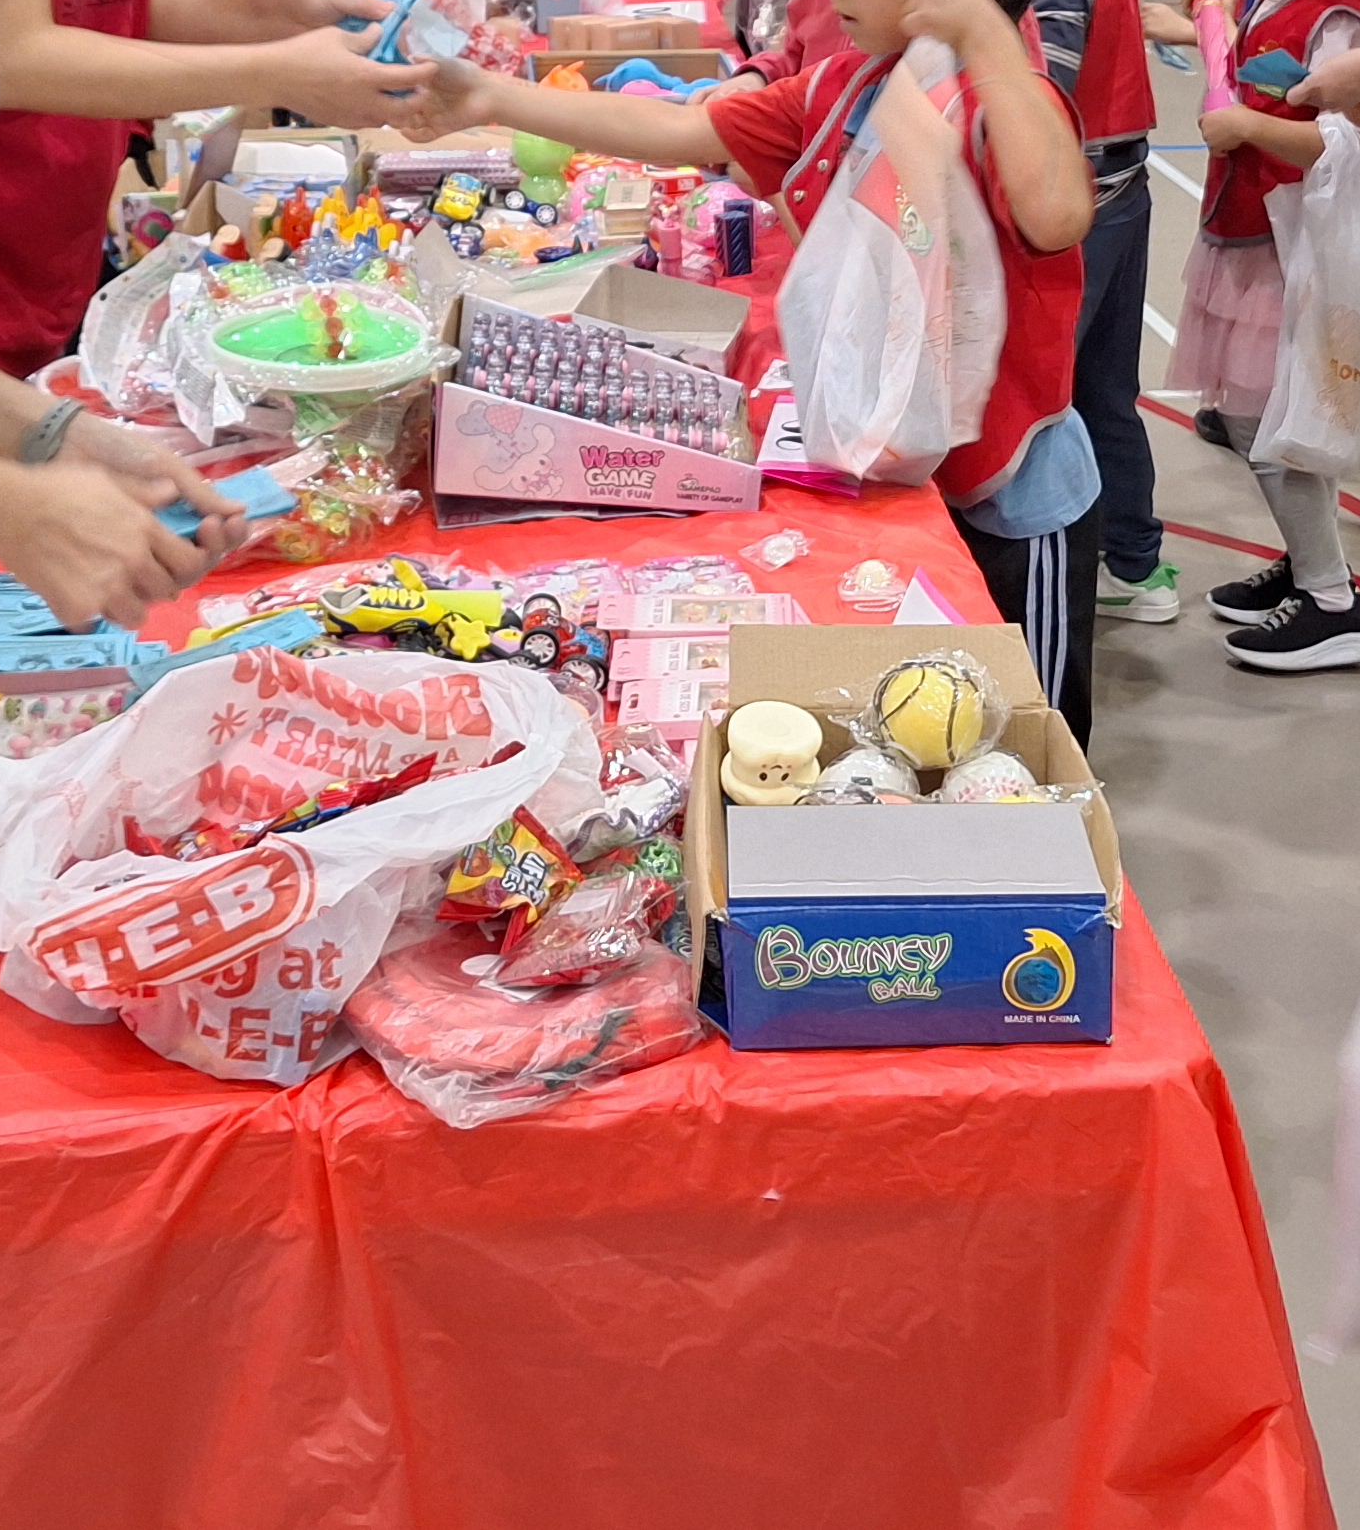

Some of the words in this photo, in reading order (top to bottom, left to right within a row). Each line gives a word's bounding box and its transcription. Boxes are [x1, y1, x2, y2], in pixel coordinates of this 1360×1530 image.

[579, 445, 665, 469] Water
[585, 467, 656, 488] GAME
[589, 487, 622, 498] HAVE
[626, 488, 653, 500] FUN
[277, 938, 343, 991] at
[869, 976, 941, 1002] BALL
[1004, 1014, 1033, 1023] MADE
[1036, 1014, 1046, 1023] IN
[1048, 1014, 1081, 1023] CHINA
